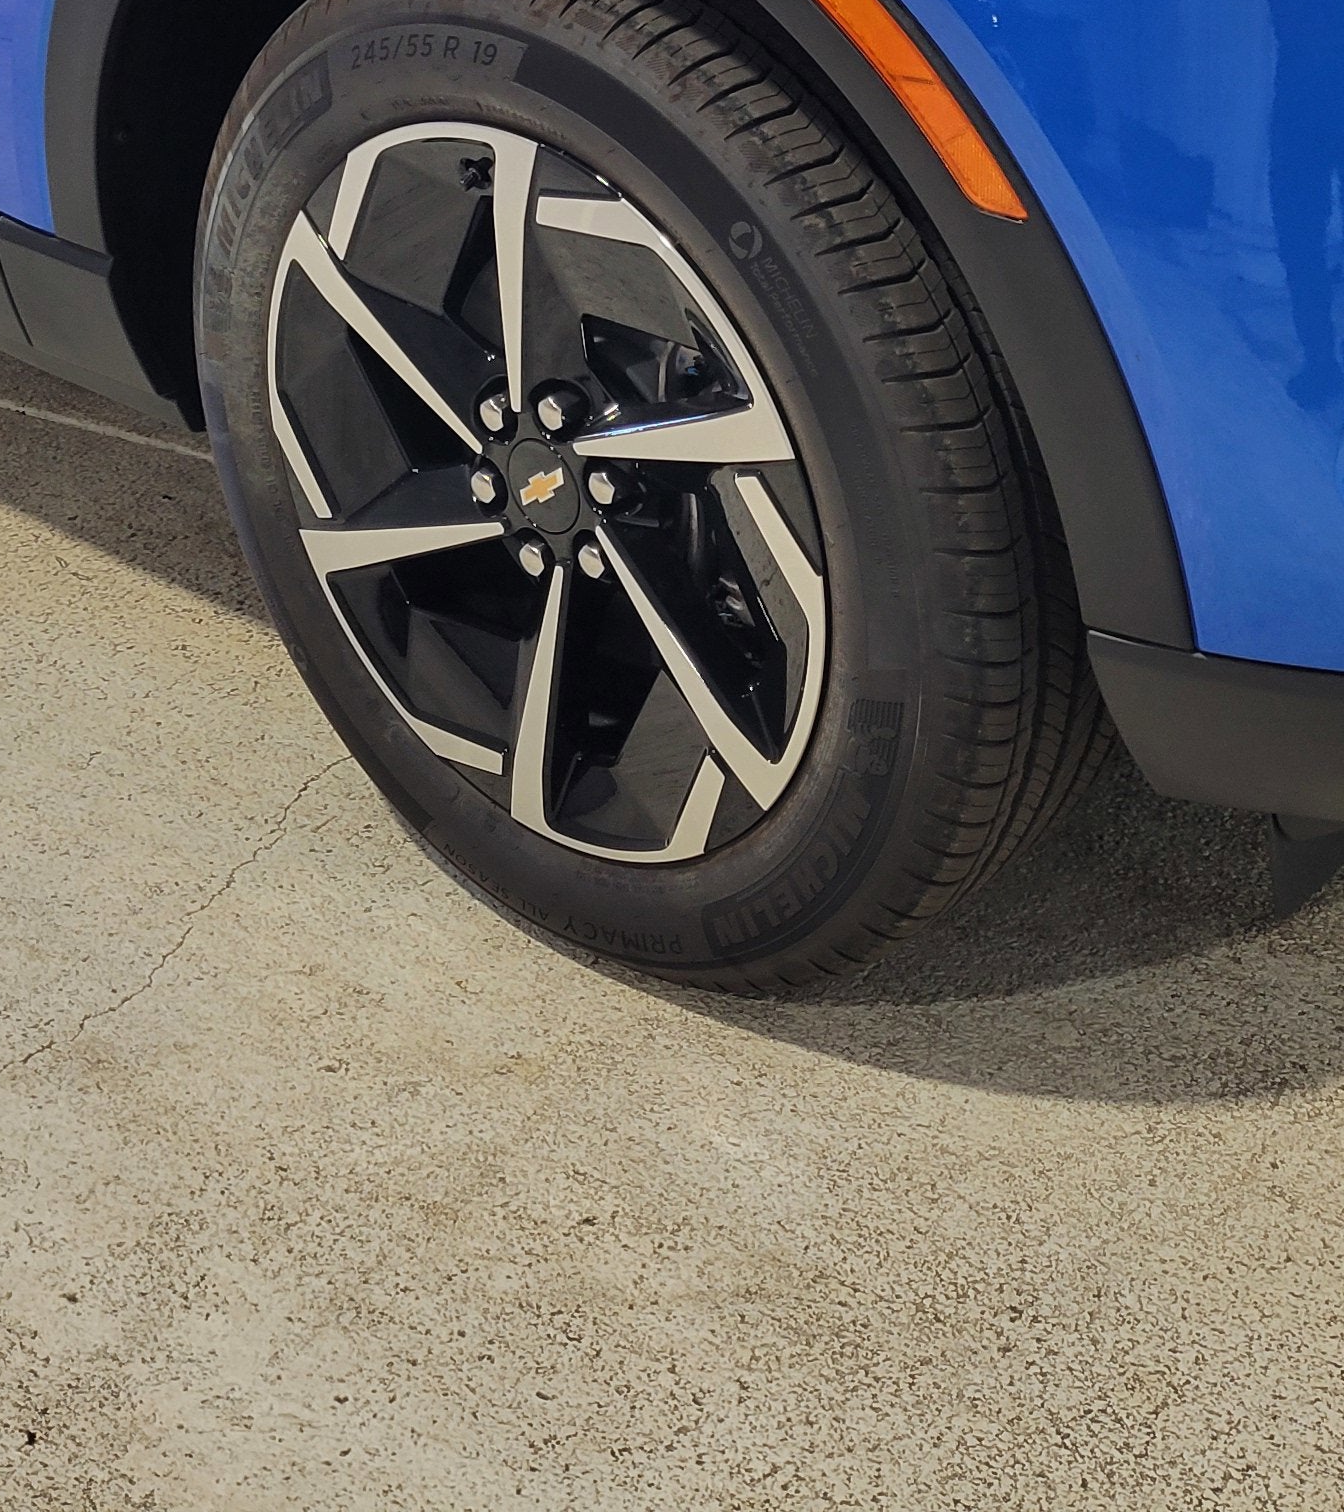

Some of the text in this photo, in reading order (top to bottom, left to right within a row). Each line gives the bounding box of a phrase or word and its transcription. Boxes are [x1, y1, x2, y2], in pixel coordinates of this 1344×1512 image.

[351, 34, 498, 70] 245/55 R 19
[760, 255, 817, 338] MICHELIN
[443, 843, 683, 955] PRIMACY ALL SEASON
[713, 788, 872, 947] MICHELIN
